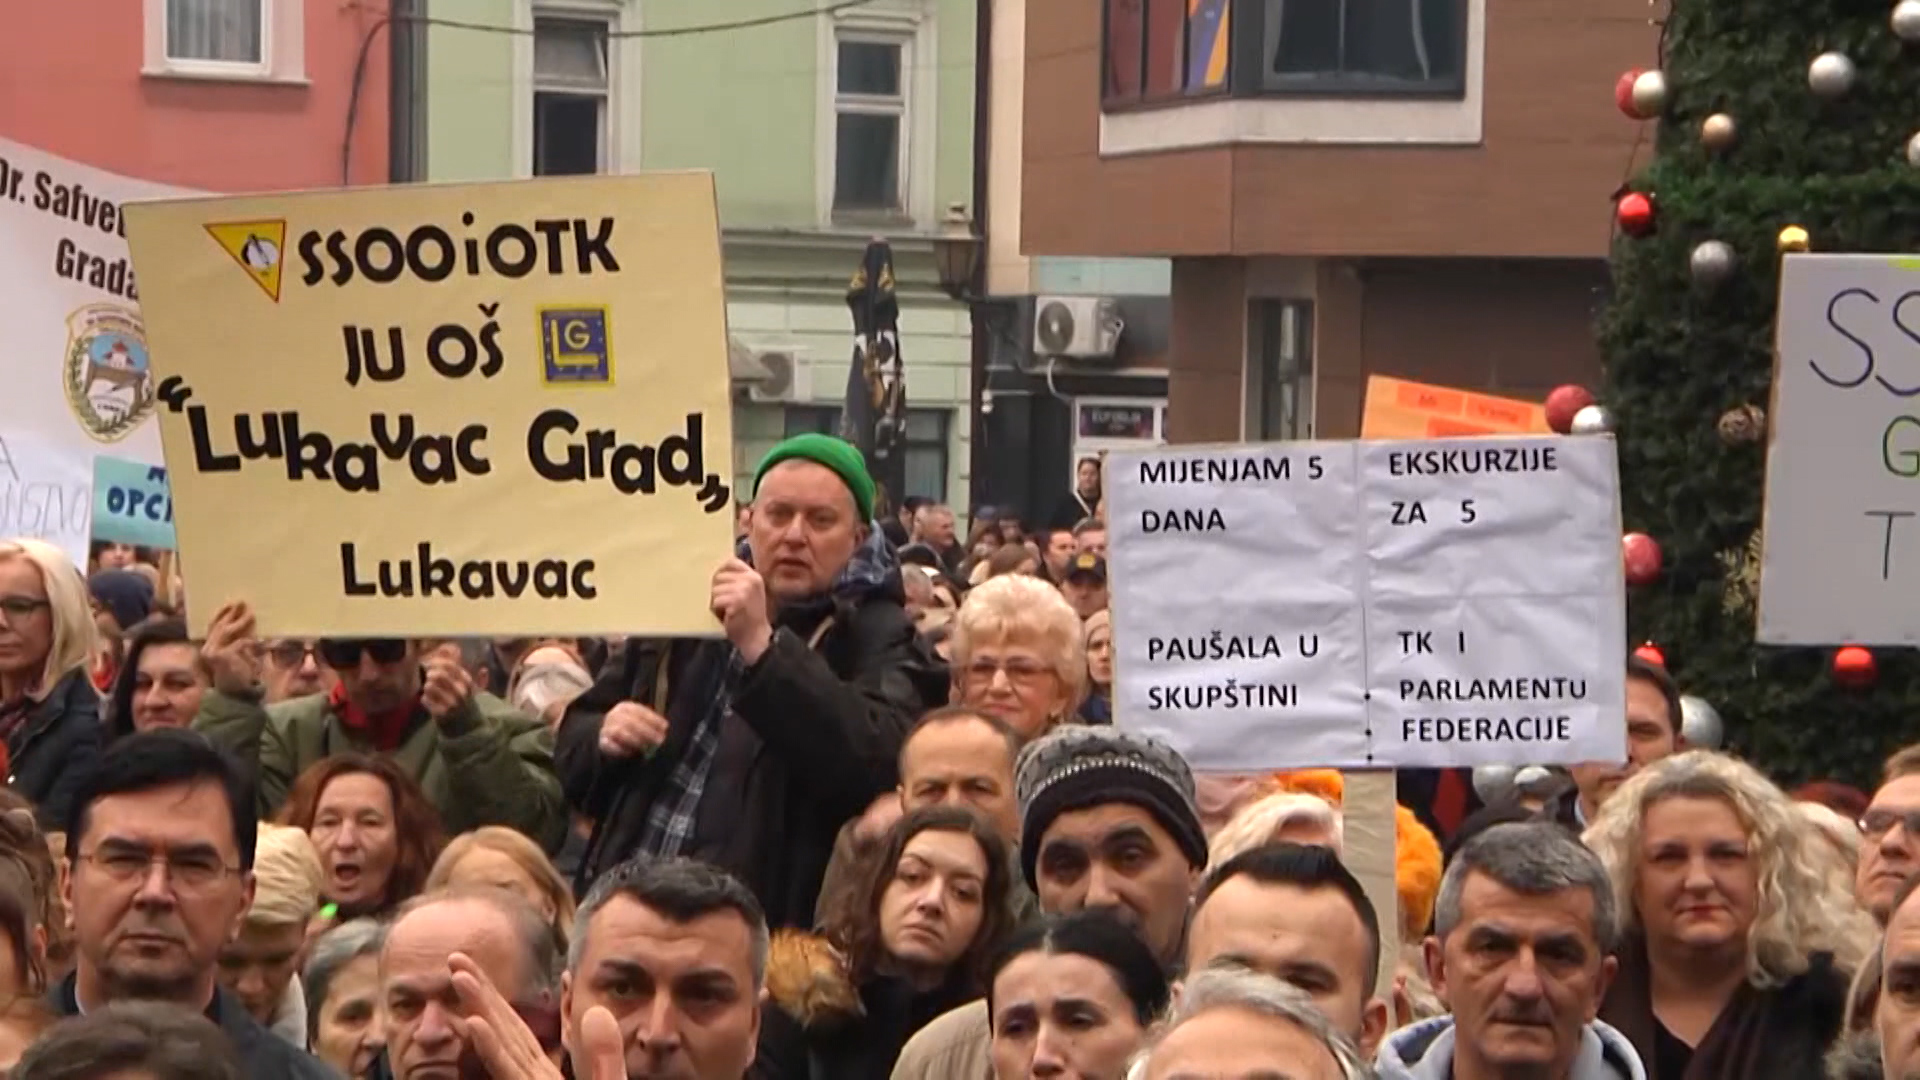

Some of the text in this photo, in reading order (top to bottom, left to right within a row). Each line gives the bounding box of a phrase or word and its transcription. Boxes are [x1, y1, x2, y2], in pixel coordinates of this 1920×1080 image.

[343, 302, 504, 387] JU OŠ
[1140, 455, 1323, 484] MIJENJAM 5
[1388, 447, 1558, 475] EKSKURZIJE
[1141, 508, 1227, 533] DANA
[1391, 499, 1476, 525] ZA 5
[341, 542, 597, 599] Lukavac
[1148, 630, 1318, 662] PAUŠALA U
[1398, 631, 1465, 654] TK I
[1148, 679, 1297, 710] SKUPŠTINI
[1400, 677, 1586, 701] PARLAMENTU
[1402, 717, 1570, 742] FEDERACIJE
